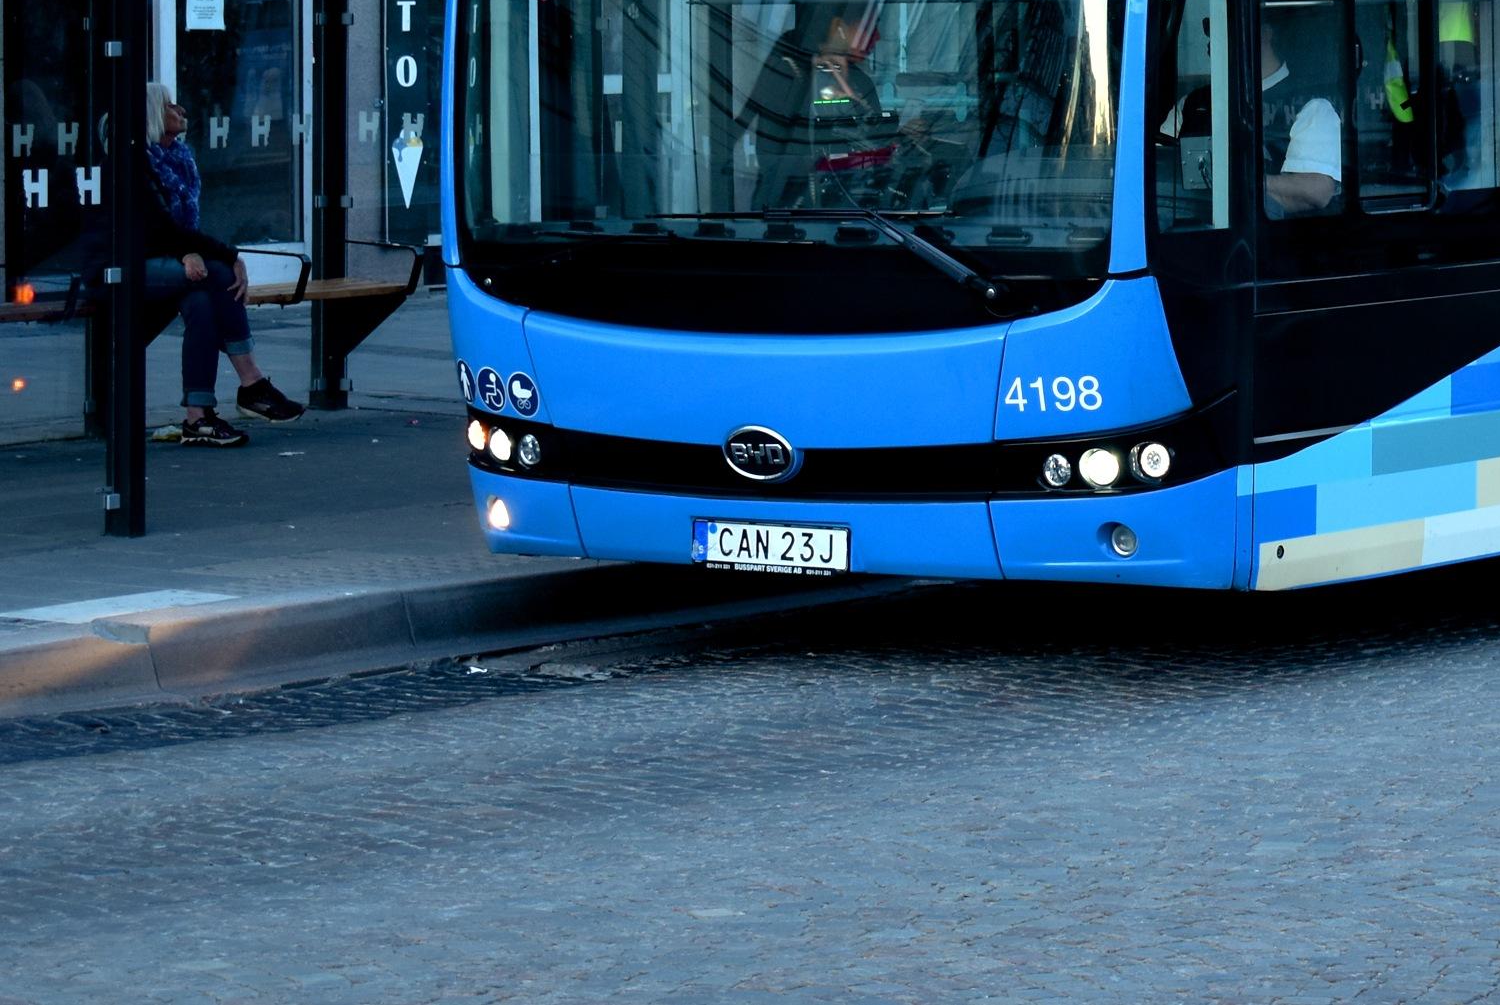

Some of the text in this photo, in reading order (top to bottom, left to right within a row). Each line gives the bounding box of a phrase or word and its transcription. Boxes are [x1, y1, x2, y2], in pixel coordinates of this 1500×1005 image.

[1004, 375, 1103, 413] 4198
[730, 442, 786, 465] BYD
[719, 527, 833, 564] CAN 23J
